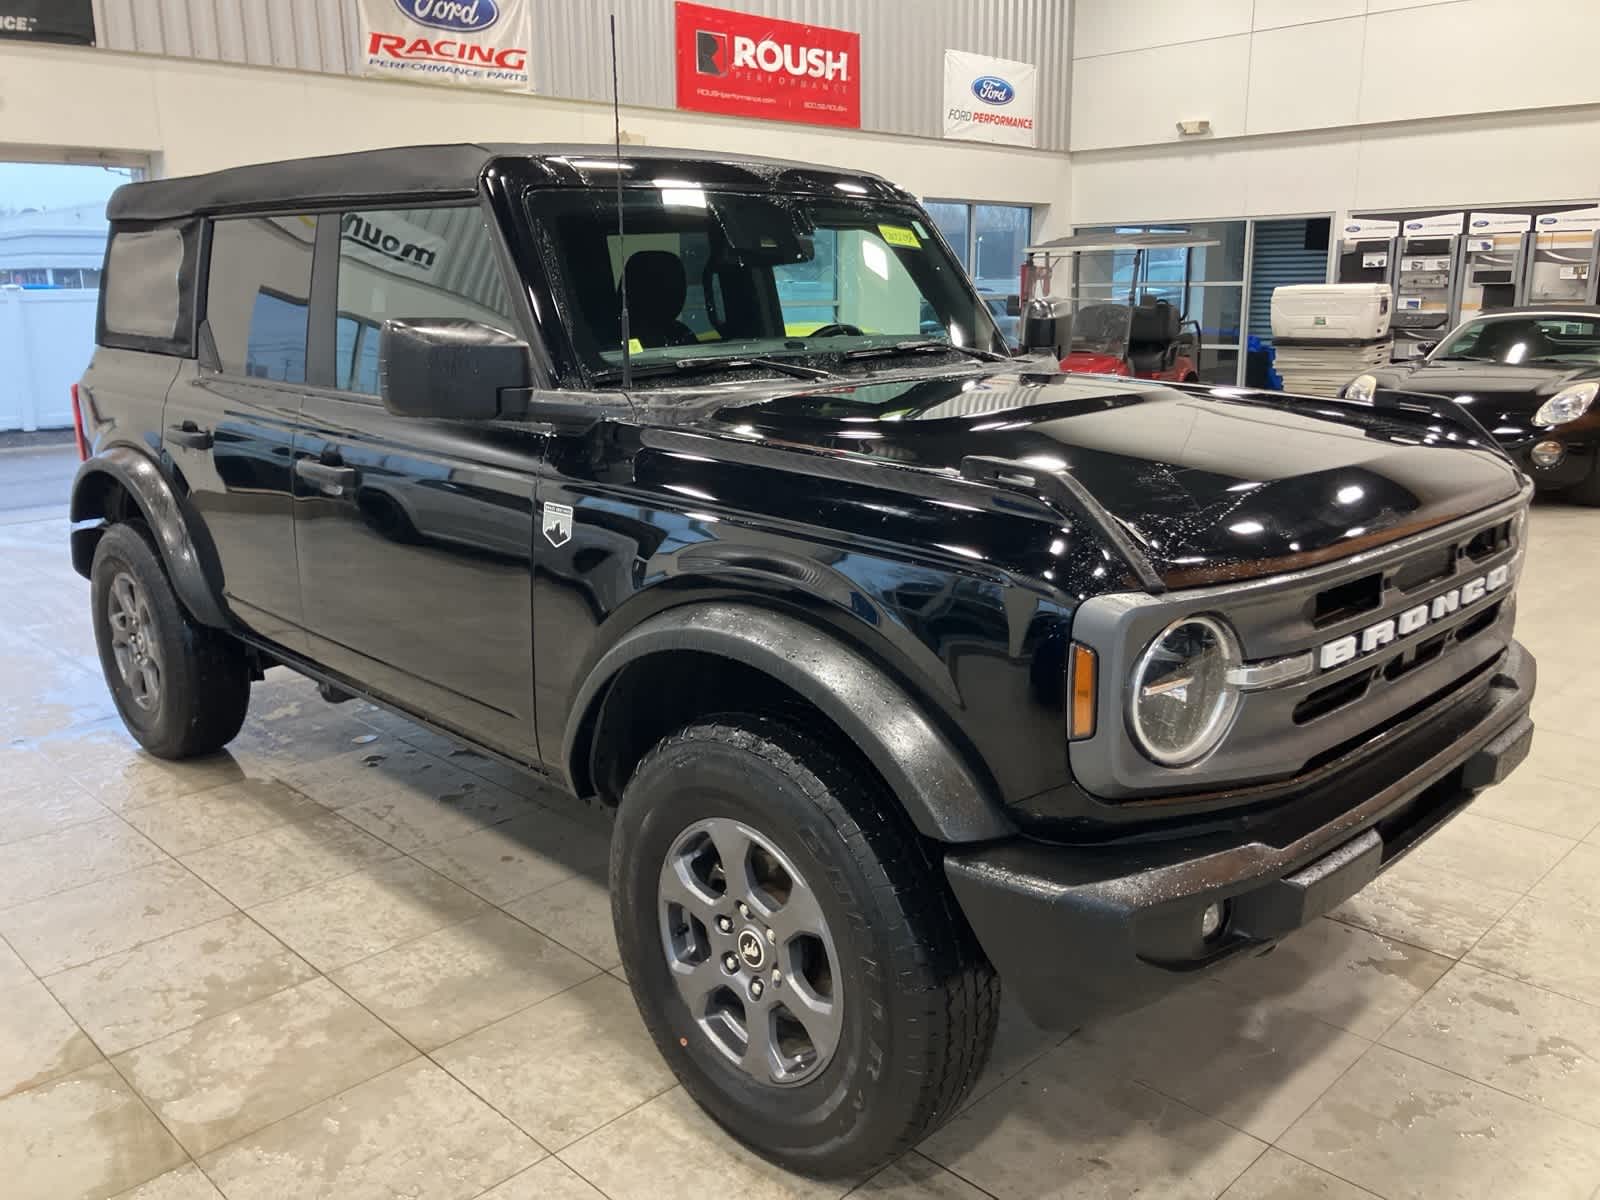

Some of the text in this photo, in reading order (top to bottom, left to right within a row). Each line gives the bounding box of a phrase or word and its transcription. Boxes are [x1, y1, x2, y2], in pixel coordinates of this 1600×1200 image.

[368, 32, 528, 71] RACING
[734, 35, 848, 81] ROUSH
[369, 58, 528, 82] PERFORMANCE PARTS
[735, 72, 848, 94] PERFORMANCE
[980, 81, 1006, 100] Ford
[948, 109, 1032, 129] FORD PERFORMANCE
[1320, 565, 1507, 669] BRONCO
